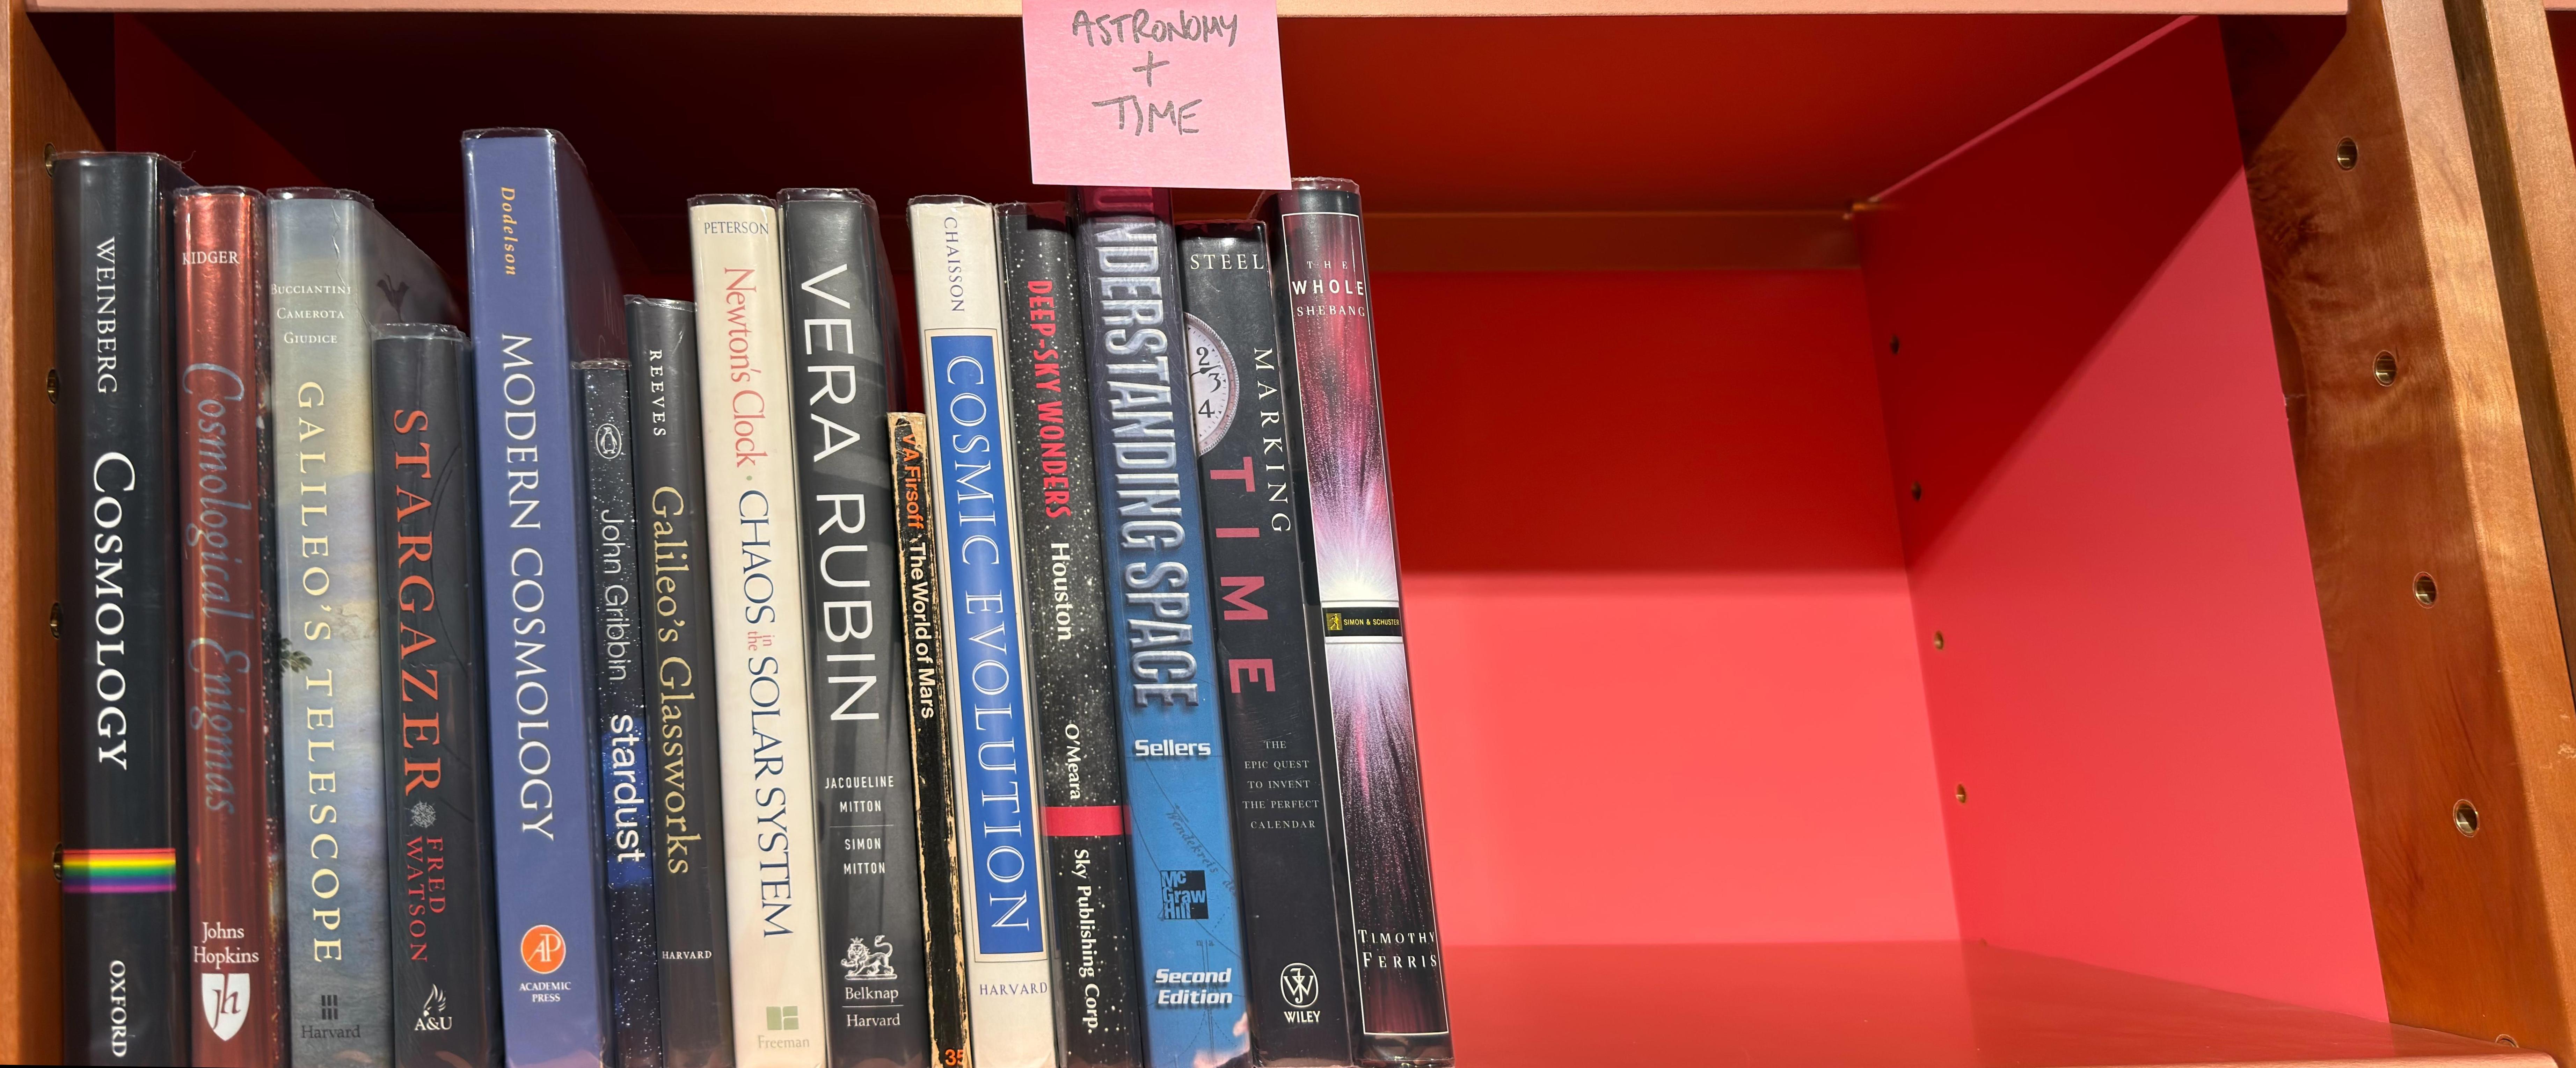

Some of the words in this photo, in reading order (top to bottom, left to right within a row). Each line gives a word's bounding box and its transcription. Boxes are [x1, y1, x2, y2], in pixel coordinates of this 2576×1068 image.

[1073, 9, 1237, 47] ASTRONOMY
[1133, 51, 1170, 87] +
[1092, 95, 1202, 136] TIME
[501, 187, 518, 276] Dodelson
[704, 221, 769, 234] PETERSON
[182, 251, 240, 265] KIDGER
[944, 217, 965, 312] CHAISSON
[1190, 254, 1264, 269] STEEL
[1307, 261, 1348, 269] THE
[271, 284, 350, 295] BUCCIANTINI
[1292, 279, 1364, 296] WHOLE
[96, 237, 117, 393] WEINBERG
[277, 308, 344, 319] CAMEROTA
[1297, 305, 1365, 317] SHEBANG
[284, 332, 337, 344] GIUDICE
[1028, 280, 1061, 392] DEEP-SKY
[802, 264, 860, 462] VERA
[1196, 347, 1210, 365] 2
[650, 349, 666, 436] REEVES
[1208, 373, 1221, 392] 3
[1198, 399, 1215, 418] 4
[502, 334, 541, 530] MODERN
[733, 390, 768, 467] Clock
[1254, 347, 1291, 532] MARKING
[947, 356, 999, 565] COSMIC
[1036, 400, 1071, 519] WONDERS
[182, 363, 254, 619] Cosmological
[904, 466, 924, 529] Firsoff
[601, 510, 626, 574] John
[739, 490, 775, 624] CHAOS
[910, 543, 927, 580] The
[1210, 456, 1276, 693] TIME
[394, 409, 441, 796] STARGAZER
[1051, 543, 1074, 641] Houston
[817, 494, 879, 720] RUBIN
[913, 582, 932, 639] World
[605, 585, 630, 680] Gribbin
[748, 631, 762, 651] the
[763, 635, 775, 647] in
[1124, 561, 1199, 708] SPACE
[916, 643, 934, 663] of
[511, 548, 554, 841] COSMOLOGY
[919, 668, 935, 718] Mars
[188, 638, 250, 814] Enigmas
[749, 657, 784, 780] SOLAR
[1135, 739, 1211, 756] Sellers
[1264, 741, 1286, 749] THE
[660, 657, 701, 874] Glassworks
[966, 589, 1030, 931] EVOLUTION
[1245, 761, 1268, 769] EPIC
[1274, 760, 1309, 769] QUEST
[611, 714, 645, 862] stardust
[825, 776, 894, 789] JACQUELINE
[1248, 780, 1263, 789] TO
[1269, 780, 1310, 789] INVENT
[306, 669, 342, 962] TELESCOPE
[840, 800, 881, 813] MITTON
[1243, 800, 1266, 809] THE
[1271, 800, 1320, 808] PERFECT
[1250, 820, 1316, 829] CALENDAR
[845, 838, 881, 850] SIMON
[756, 787, 794, 938] SYSTEM
[844, 862, 885, 874] MITTON
[1071, 848, 1092, 879] Sky
[426, 836, 446, 914] FRED
[406, 836, 427, 962] WATSON
[1162, 886, 1206, 903] Graw
[1164, 901, 1191, 919] Hill
[202, 922, 245, 943] Johns
[1078, 886, 1097, 978] Publishing
[1358, 929, 1434, 944] TIMOTHY
[194, 946, 259, 969] Hopkins
[528, 933, 561, 961] AP
[662, 950, 712, 959] HARVARD
[1362, 952, 1437, 968] FERRIS
[519, 982, 571, 991] ACADEMIC
[1155, 968, 1232, 983] Second
[532, 994, 560, 1002] PRESS
[845, 987, 899, 1003] Belknap
[980, 982, 1048, 996] HARVARD
[1158, 989, 1233, 1004] Edition
[110, 960, 127, 1057] OXFORD
[846, 1013, 901, 1027] Harvard
[1082, 983, 1100, 1034] Corp.
[1284, 1011, 1320, 1023] WILEY
[301, 1025, 360, 1039] Harvard
[415, 1016, 452, 1031] A&U
[757, 1035, 810, 1048] Freeman
